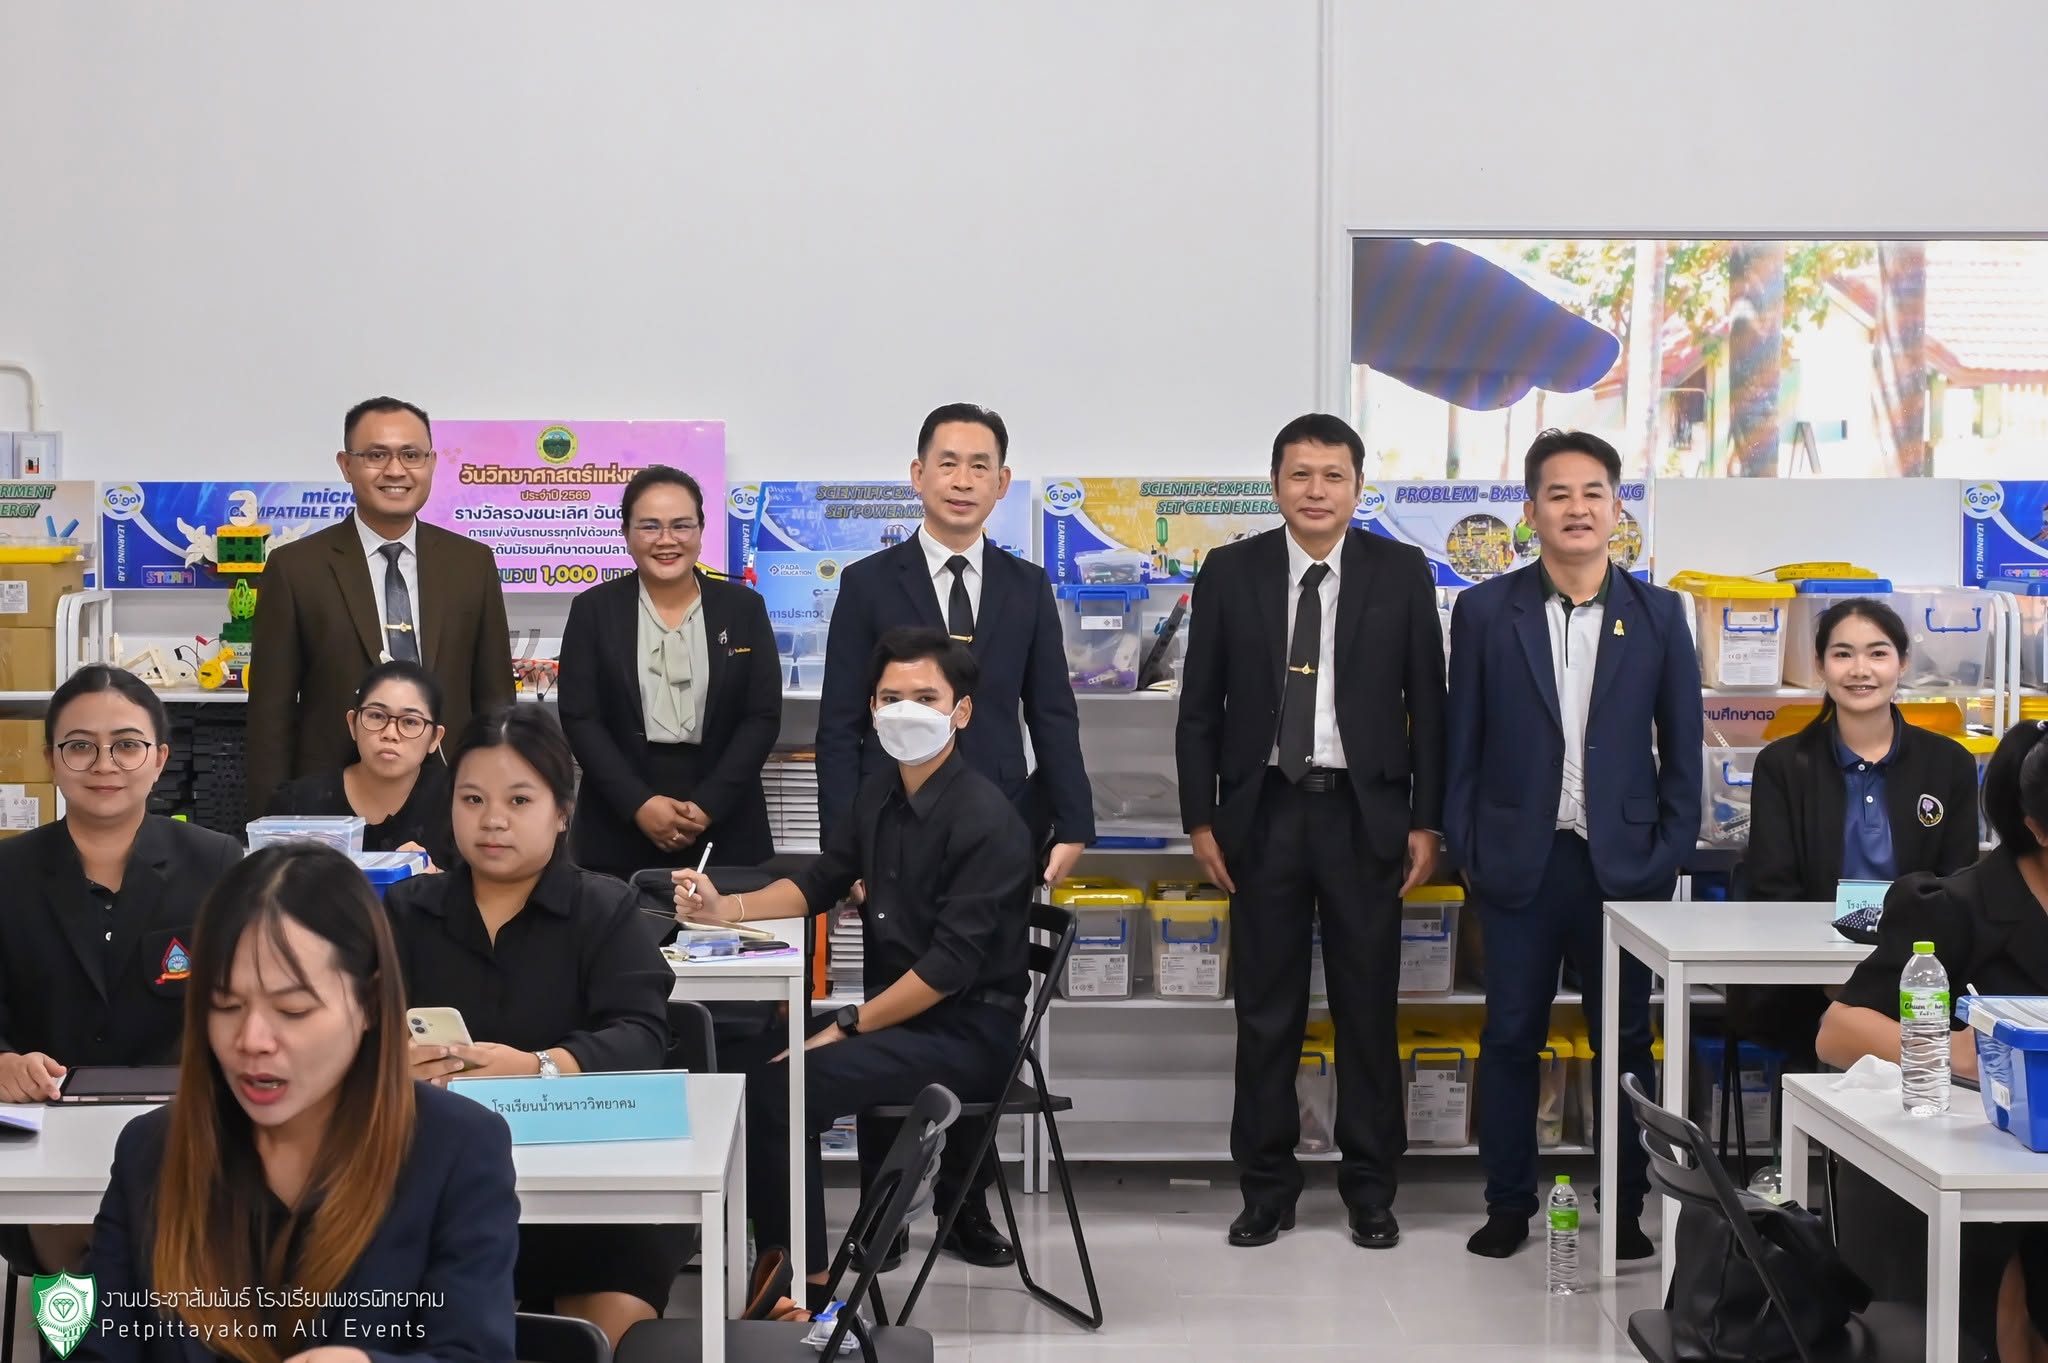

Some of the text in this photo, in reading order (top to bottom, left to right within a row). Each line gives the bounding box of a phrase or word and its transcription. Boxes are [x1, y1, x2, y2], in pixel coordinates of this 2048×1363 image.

[521, 489, 559, 501] ประจำปี
[816, 485, 891, 500] SCIENTIFIC
[1140, 481, 1216, 496] SCIENTIFIC
[1395, 485, 1479, 504] PROBLEM
[229, 506, 330, 518] CMPATIBLE
[455, 505, 588, 520] รางวัลรองชนะเลิศ
[825, 503, 853, 519] SET
[853, 503, 904, 519] POWER
[1156, 500, 1183, 515] SET
[1184, 500, 1231, 515] GREEN
[117, 524, 126, 582] LEARNING LAB
[1057, 520, 1066, 577] LEARNING LAB
[1976, 523, 1984, 580] LEARNING LAB
[146, 571, 192, 584] STEAM
[541, 565, 598, 586] 1,000
